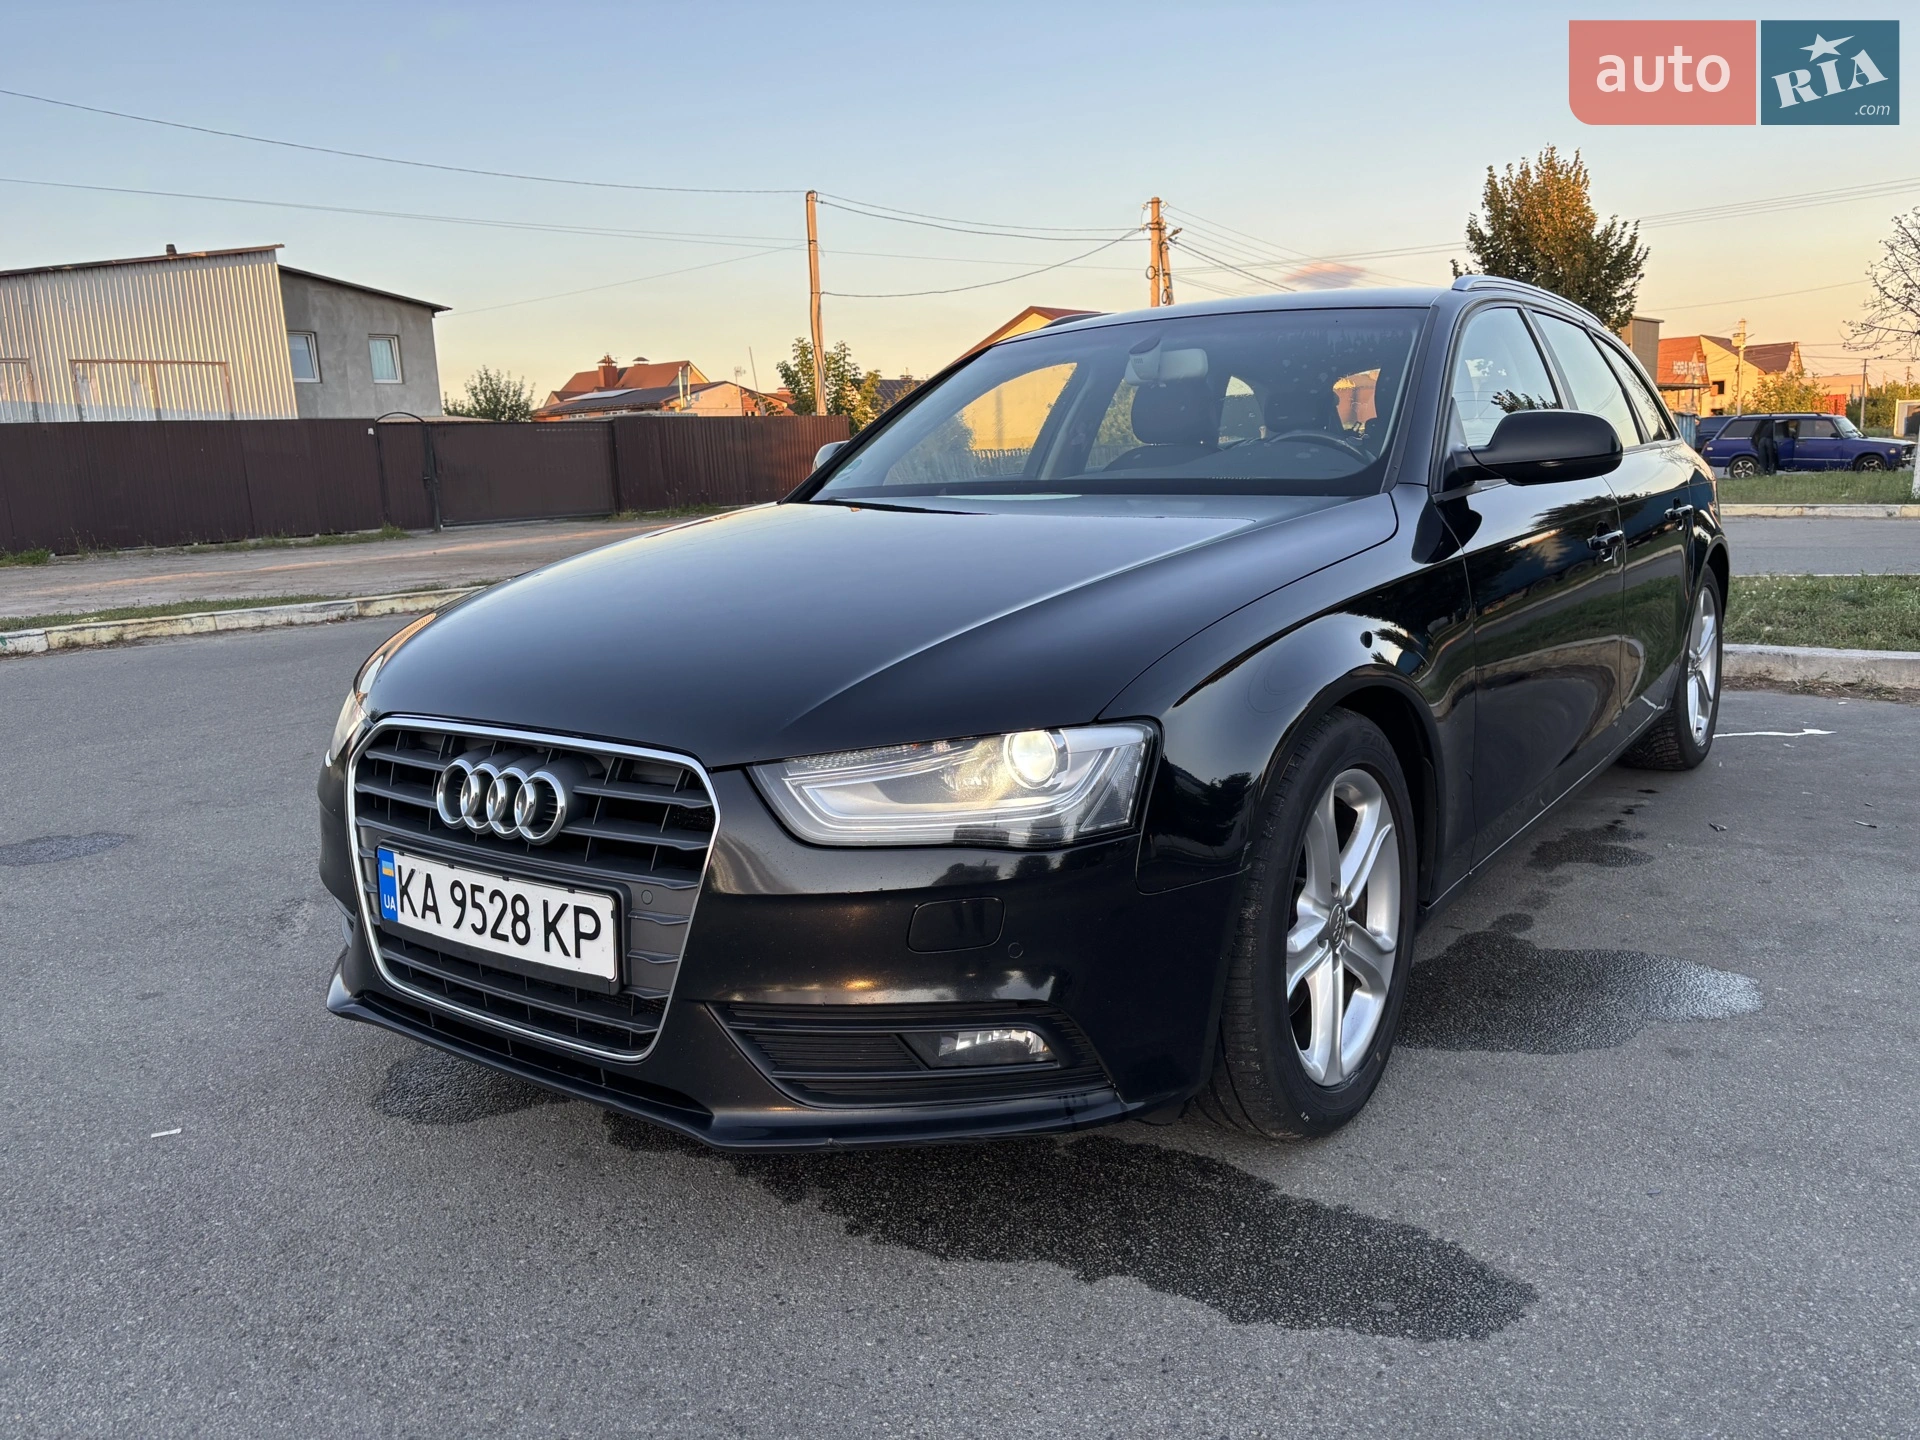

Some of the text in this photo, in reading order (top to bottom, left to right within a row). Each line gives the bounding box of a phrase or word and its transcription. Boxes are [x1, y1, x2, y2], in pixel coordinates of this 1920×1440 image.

[384, 893, 396, 910] UA
[398, 864, 602, 959] KA 9528 KP
